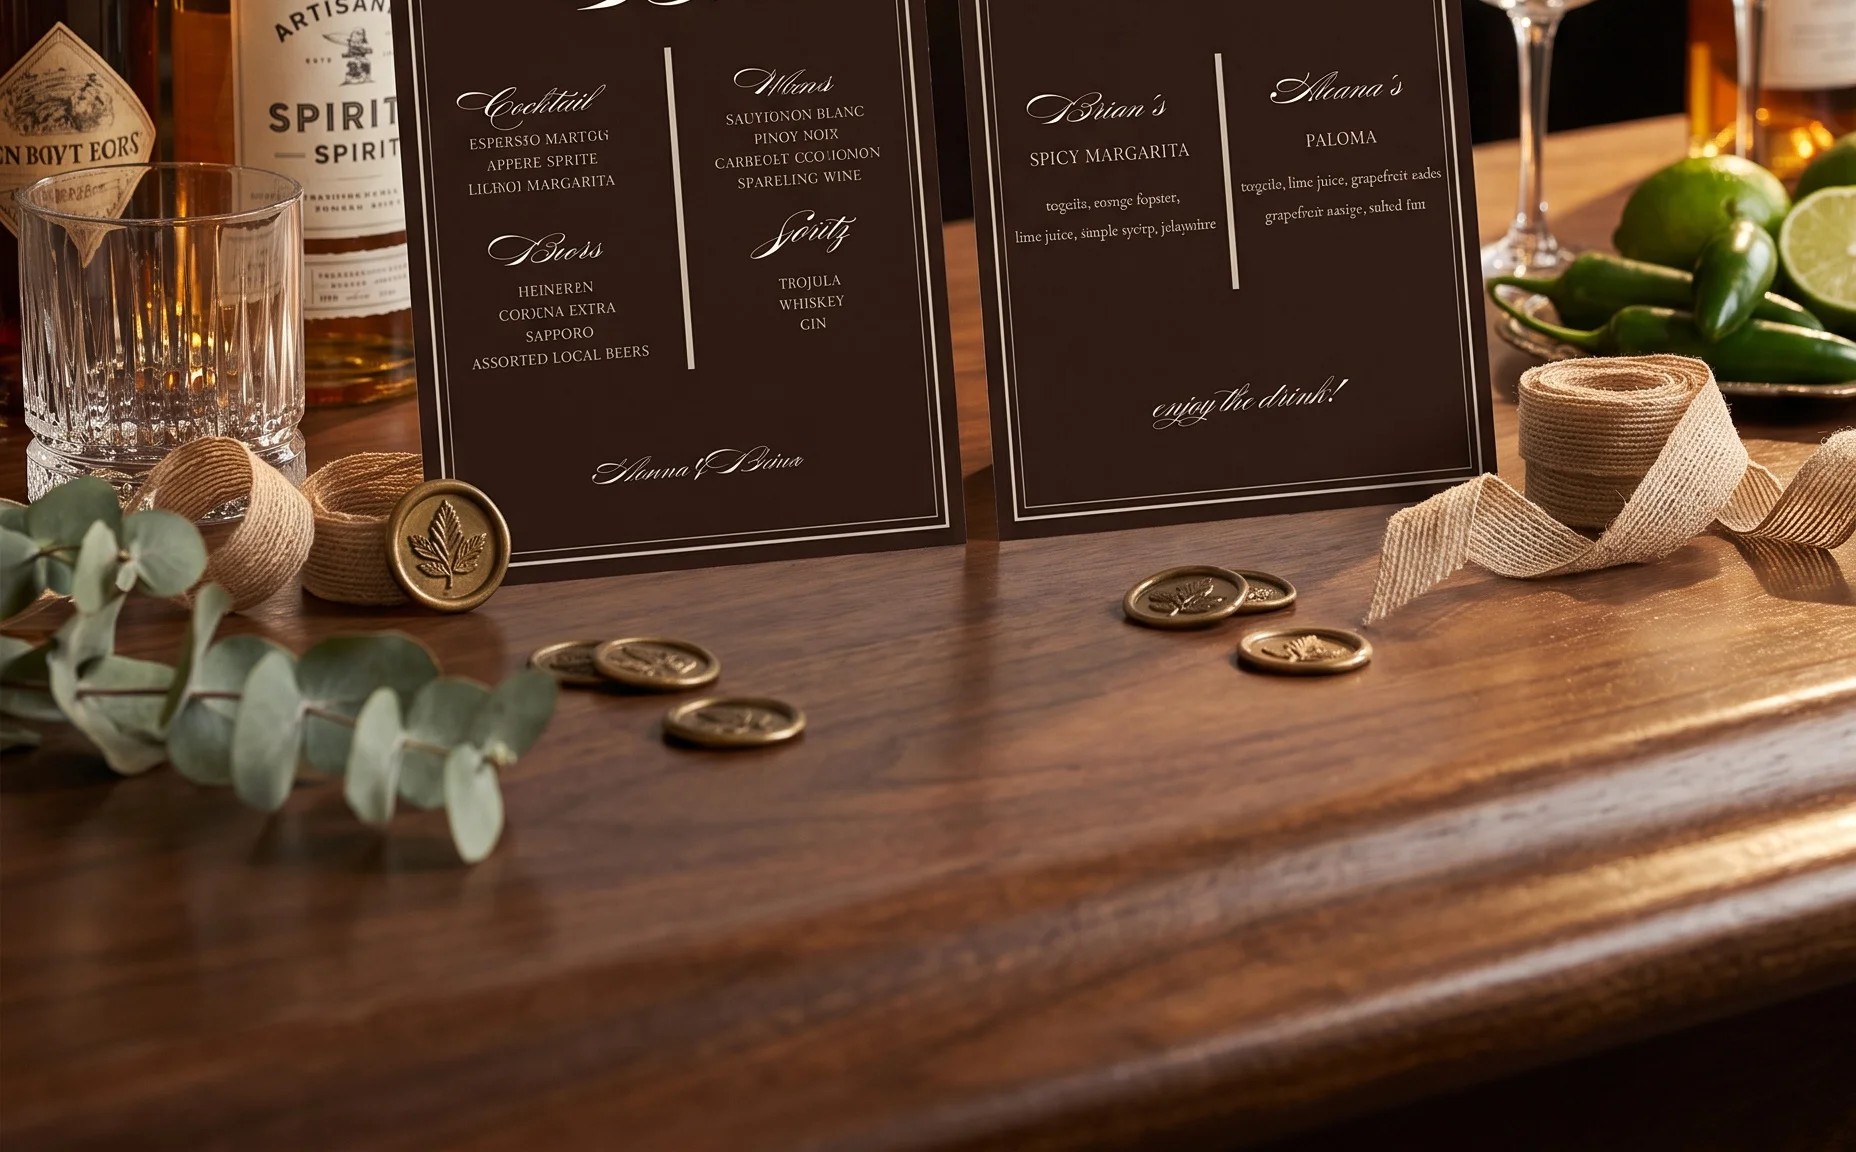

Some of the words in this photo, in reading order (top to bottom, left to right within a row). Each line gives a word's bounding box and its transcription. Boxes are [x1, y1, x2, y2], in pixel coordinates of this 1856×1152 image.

[456, 84, 606, 131] Cocktail
[817, 105, 865, 120] BLANC
[754, 131, 798, 145] PINOY
[1306, 130, 1378, 148] PALOMA
[315, 137, 400, 165] SPIRIT
[1030, 150, 1079, 167] SPICY
[1086, 142, 1190, 164] MARGARITA
[547, 152, 598, 168] SPRITE
[527, 174, 615, 192] MARGARITA
[823, 169, 862, 183] WINE
[1288, 175, 1314, 190] lime
[1316, 173, 1348, 192] juice,
[1015, 230, 1042, 244] lime
[1044, 228, 1077, 246] juice,
[778, 274, 841, 291] TROJULA
[569, 301, 616, 316] EXTRA
[779, 294, 844, 311] WHISKEY
[800, 317, 826, 330] GIN
[526, 326, 594, 343] SAPPORO
[472, 353, 548, 370] ASSORTED
[552, 349, 601, 364] LOCAL
[605, 344, 650, 360] BEERS
[1152, 396, 1216, 430] enjoy
[1214, 383, 1255, 411] the
[1258, 375, 1349, 409] drink!
